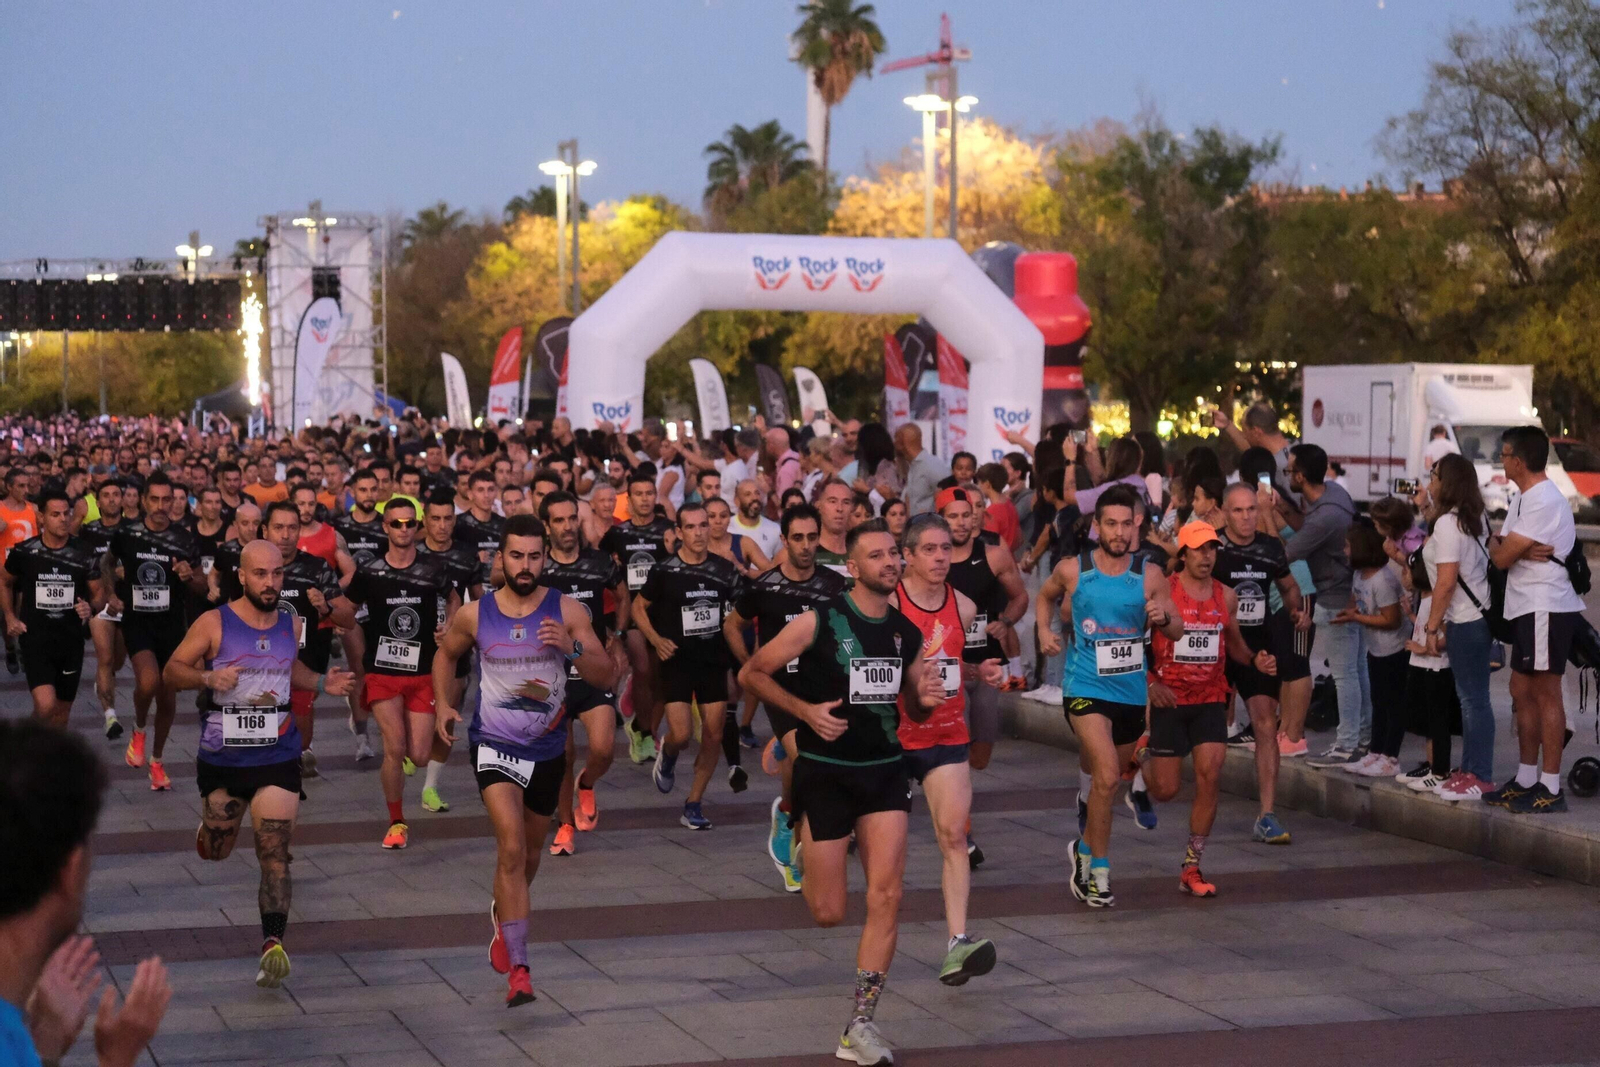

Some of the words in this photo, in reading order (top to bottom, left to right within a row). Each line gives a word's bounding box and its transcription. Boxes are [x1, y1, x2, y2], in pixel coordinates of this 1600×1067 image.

[753, 256, 791, 276] Rock
[798, 256, 839, 277] Rock
[845, 257, 885, 278] Rock
[592, 401, 632, 421] Rock
[993, 406, 1032, 427] Rock
[136, 552, 170, 562] RUNMONES
[38, 573, 72, 581] RUNMONES
[1231, 571, 1267, 579] RUNMONES
[46, 588, 64, 598] 386
[142, 591, 160, 600] 586
[280, 589, 299, 597] ONES
[686, 590, 718, 598] RUNMONES
[1239, 602, 1256, 613] 412
[694, 610, 711, 622] 253
[1188, 636, 1209, 648] 666
[388, 645, 410, 657] 1316
[1111, 646, 1132, 659] 944
[863, 668, 893, 683] 1000
[236, 715, 265, 729] 1168
